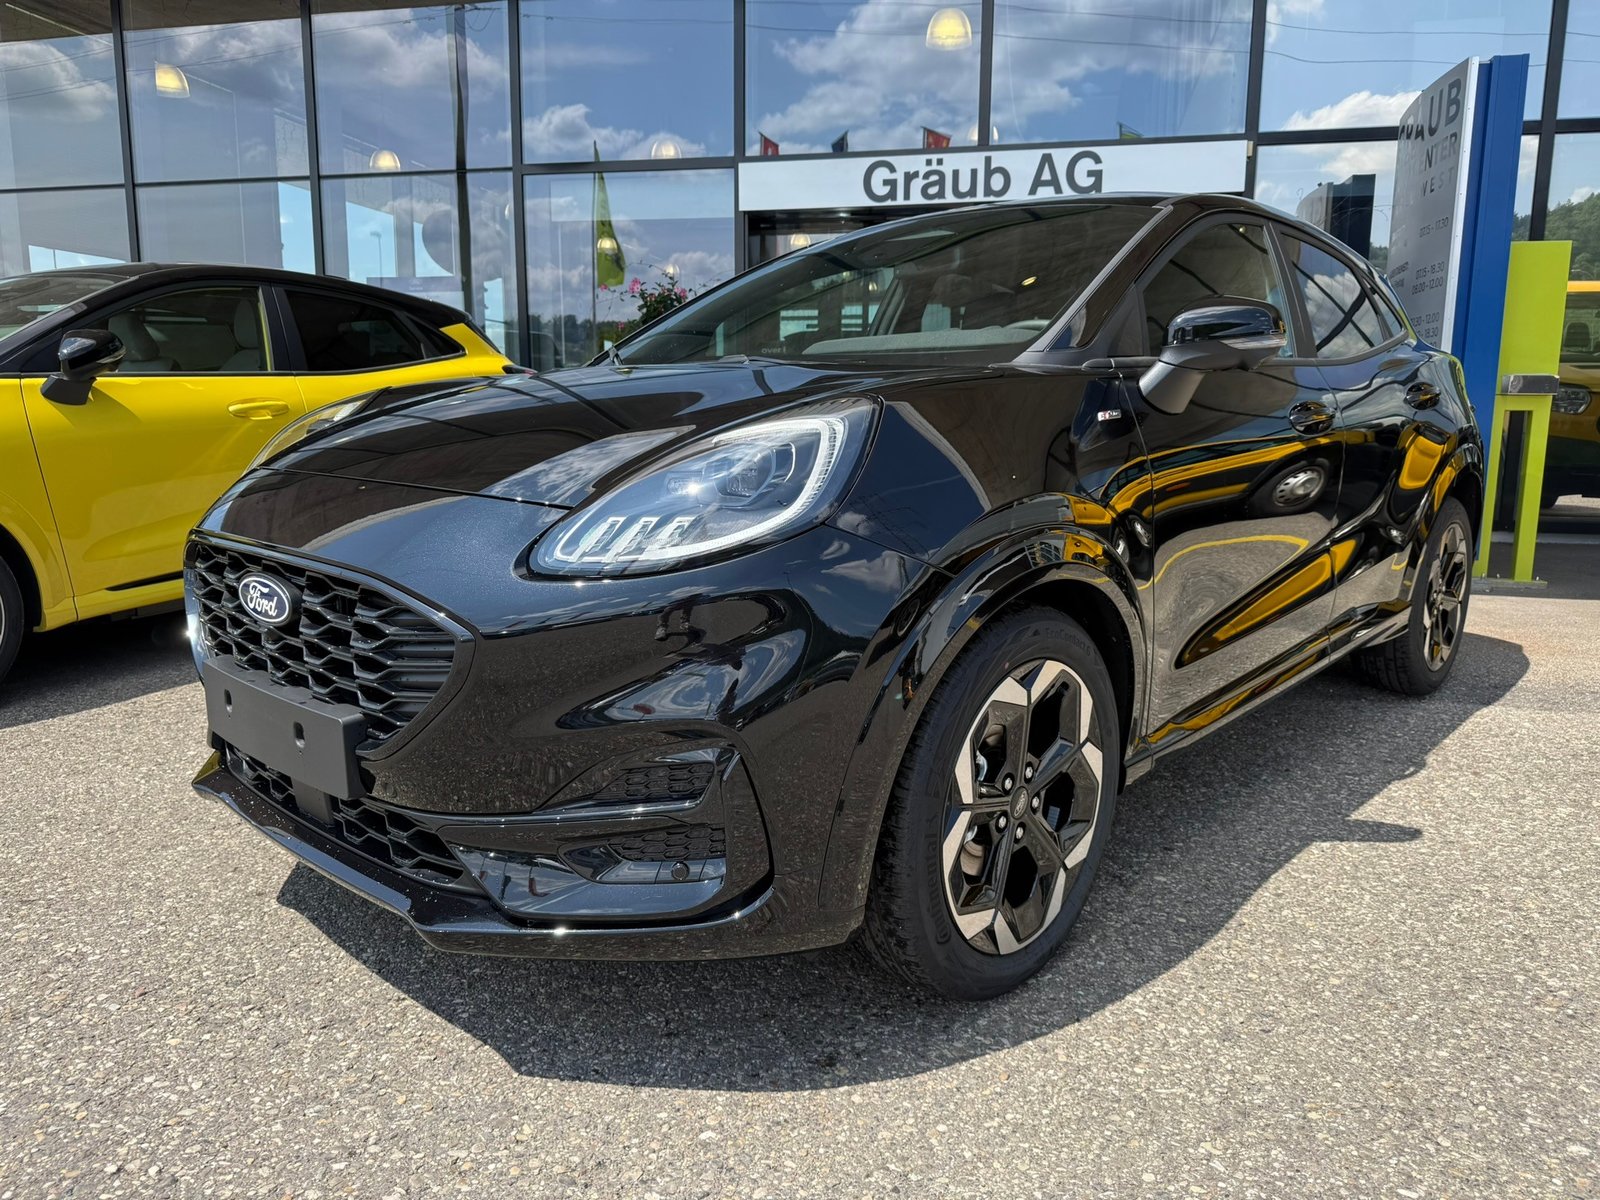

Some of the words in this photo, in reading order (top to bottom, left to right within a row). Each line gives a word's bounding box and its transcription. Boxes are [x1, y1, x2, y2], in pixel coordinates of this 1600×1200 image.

[862, 155, 1012, 203] Gräub
[1028, 150, 1104, 197] AG
[247, 582, 278, 617] Ford
